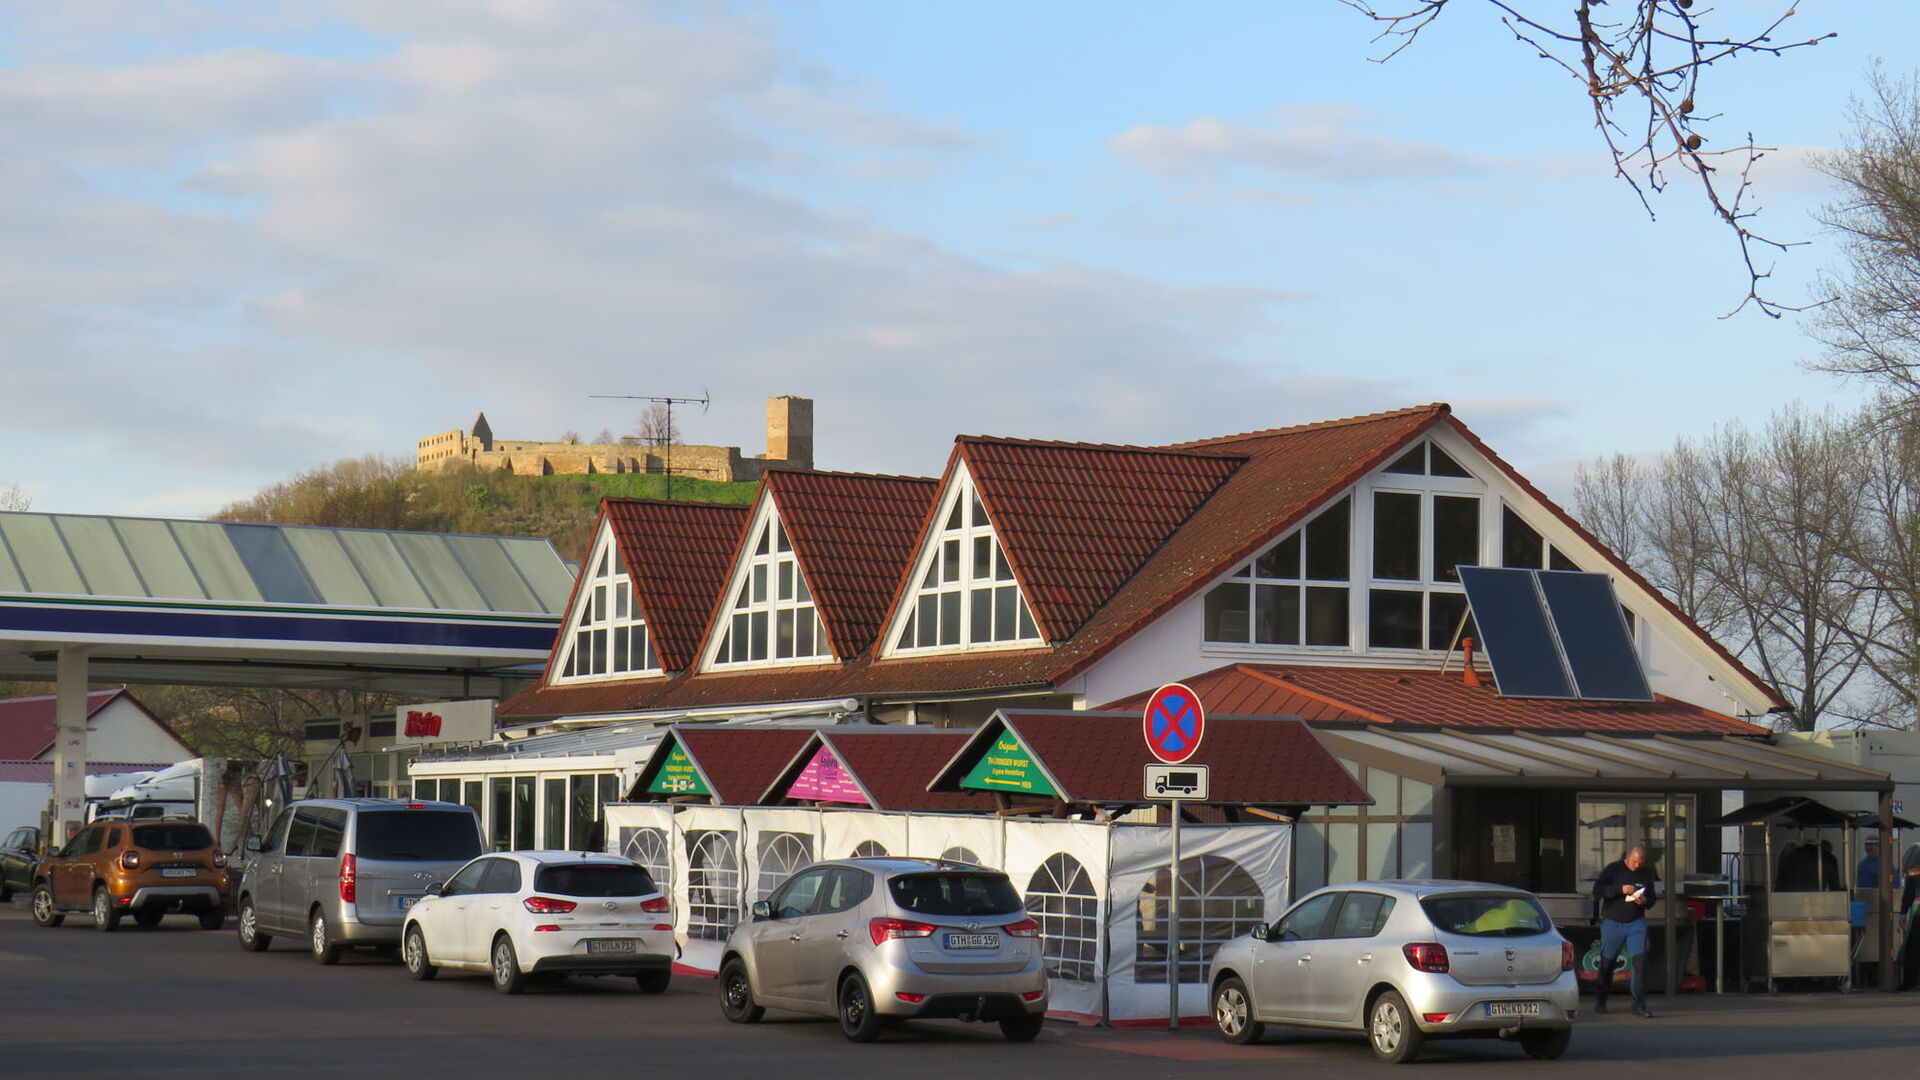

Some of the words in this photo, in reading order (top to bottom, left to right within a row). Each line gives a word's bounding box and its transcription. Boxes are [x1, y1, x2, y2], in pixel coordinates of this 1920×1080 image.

[951, 935, 966, 945] GTH
[971, 935, 982, 945] GG
[984, 935, 998, 945] 159
[592, 941, 606, 951] GTH
[1491, 1003, 1506, 1014] GTH
